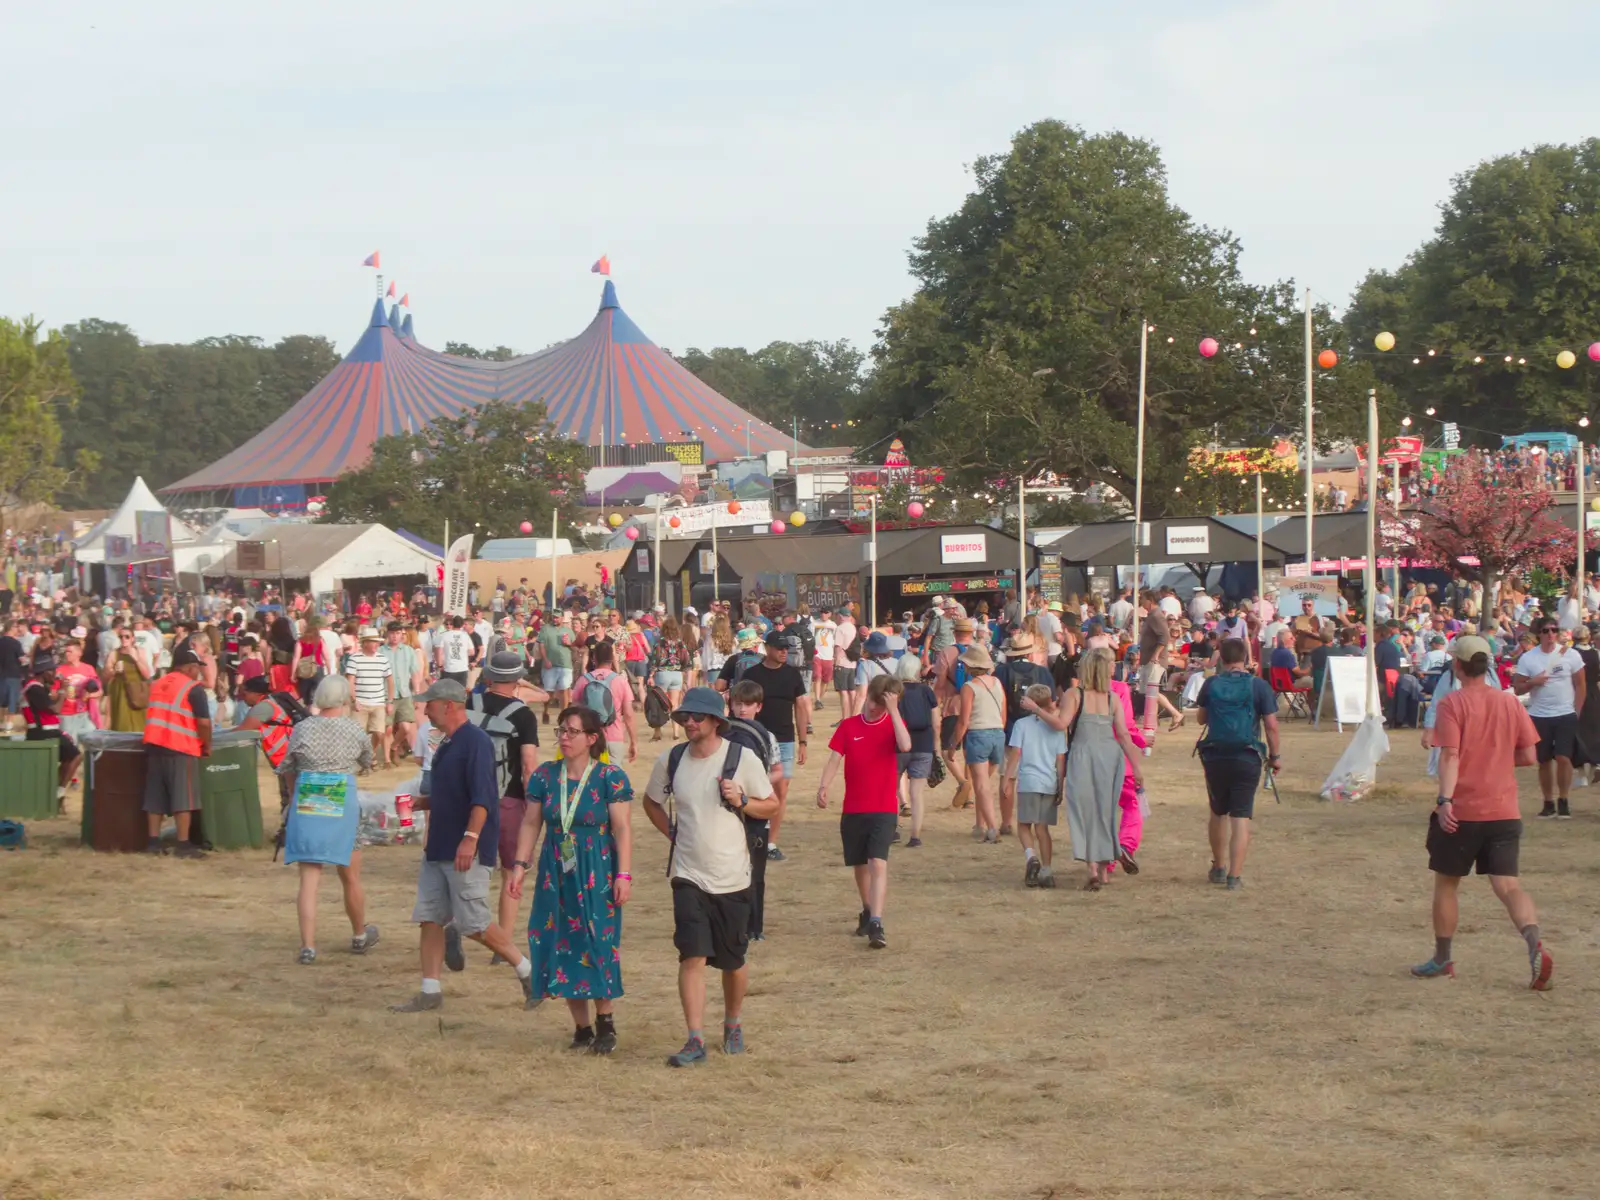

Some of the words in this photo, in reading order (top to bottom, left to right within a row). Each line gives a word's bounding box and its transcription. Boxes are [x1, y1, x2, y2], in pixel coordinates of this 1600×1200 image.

[665, 444, 701, 453] CHICKEN
[945, 543, 983, 553] BURRITOS
[450, 568, 459, 610] CHOCOLATE
[457, 571, 465, 608] FOUNTAIN
[1290, 582, 1308, 592] FREE
